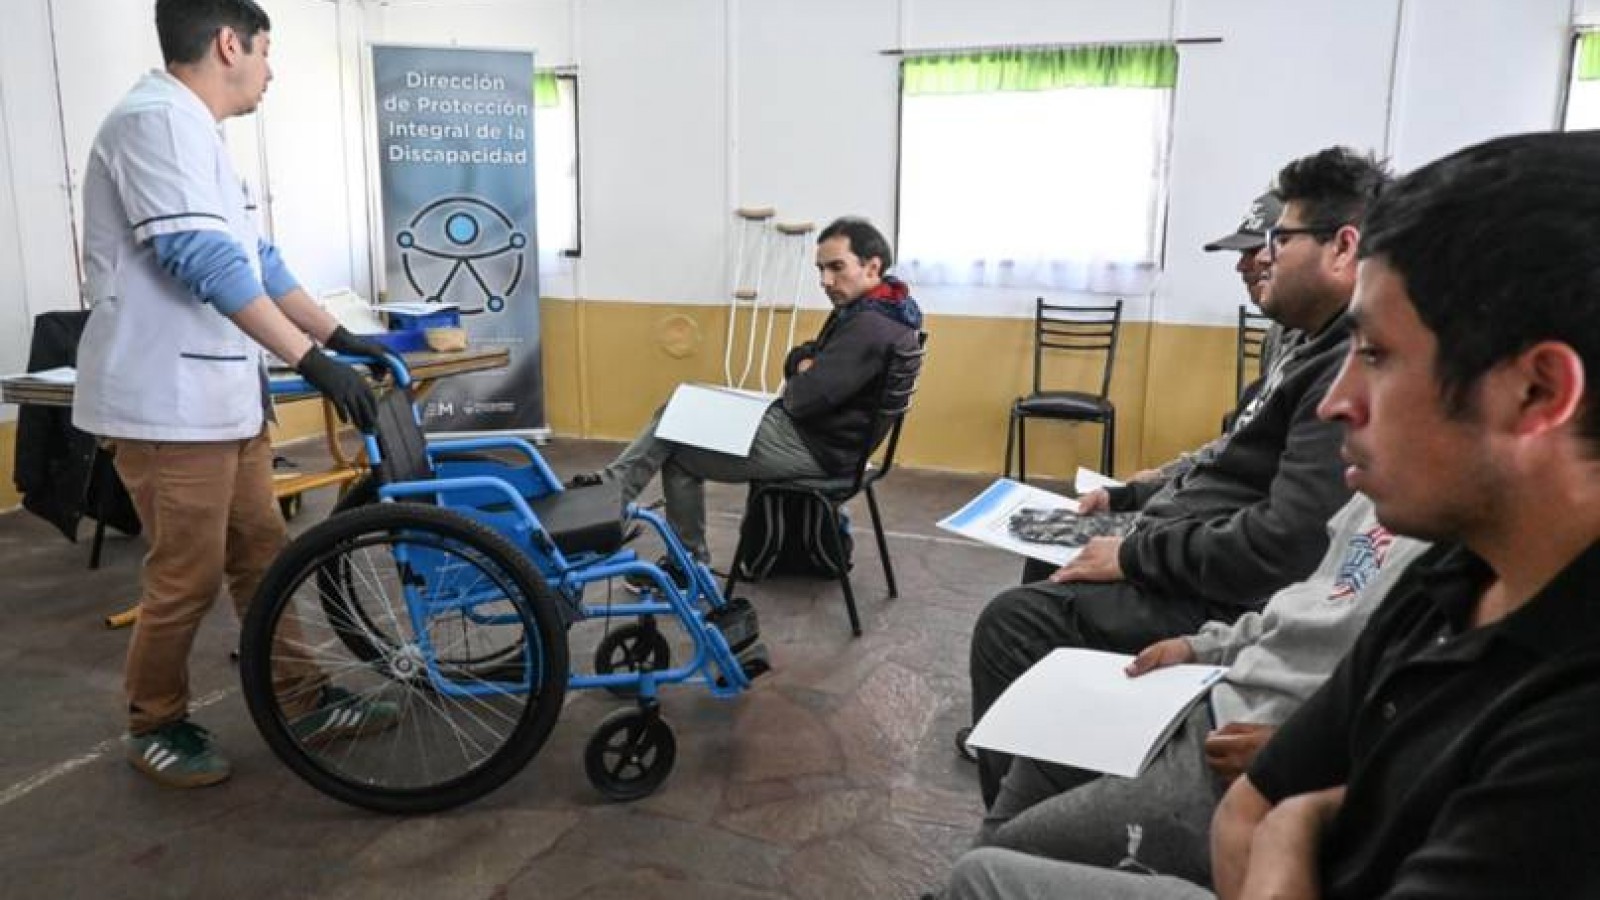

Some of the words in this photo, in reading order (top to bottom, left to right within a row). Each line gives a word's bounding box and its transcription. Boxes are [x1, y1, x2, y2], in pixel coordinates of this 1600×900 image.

[406, 71, 505, 90] Dirección
[384, 95, 410, 112] de
[417, 97, 528, 116] Protección
[389, 121, 469, 139] Integral
[476, 123, 502, 140] de
[508, 124, 525, 140] la
[388, 145, 526, 165] Discapacidad
